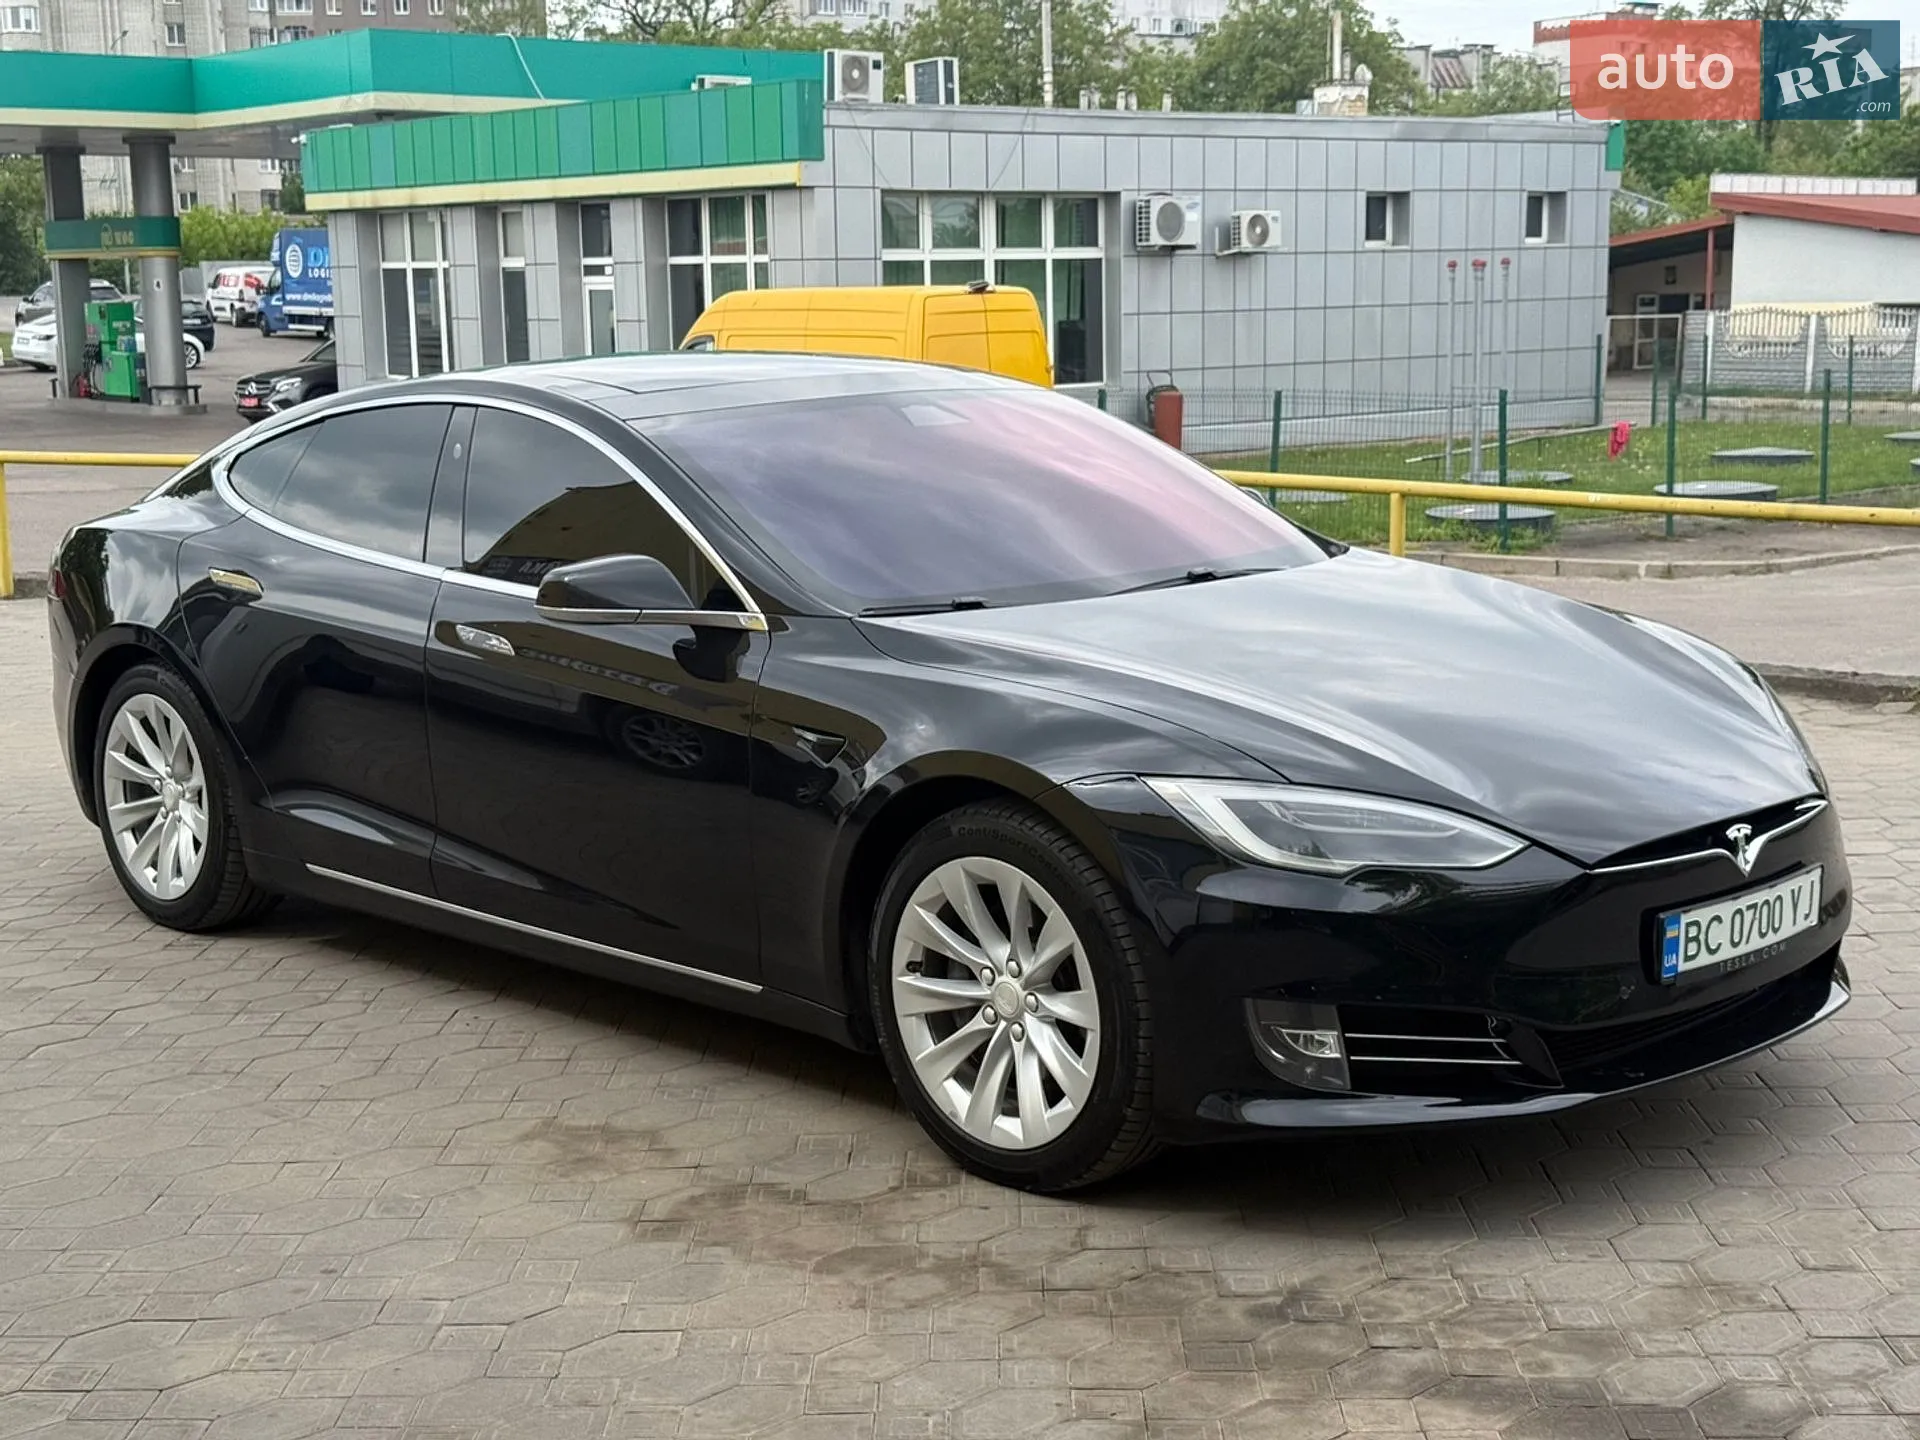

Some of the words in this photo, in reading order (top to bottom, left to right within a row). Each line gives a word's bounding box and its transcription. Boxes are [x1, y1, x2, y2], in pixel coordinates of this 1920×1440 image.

[1683, 914, 1724, 963] BC
[1730, 894, 1784, 949] 0700
[1790, 879, 1815, 927] YJ
[1663, 953, 1677, 968] UA
